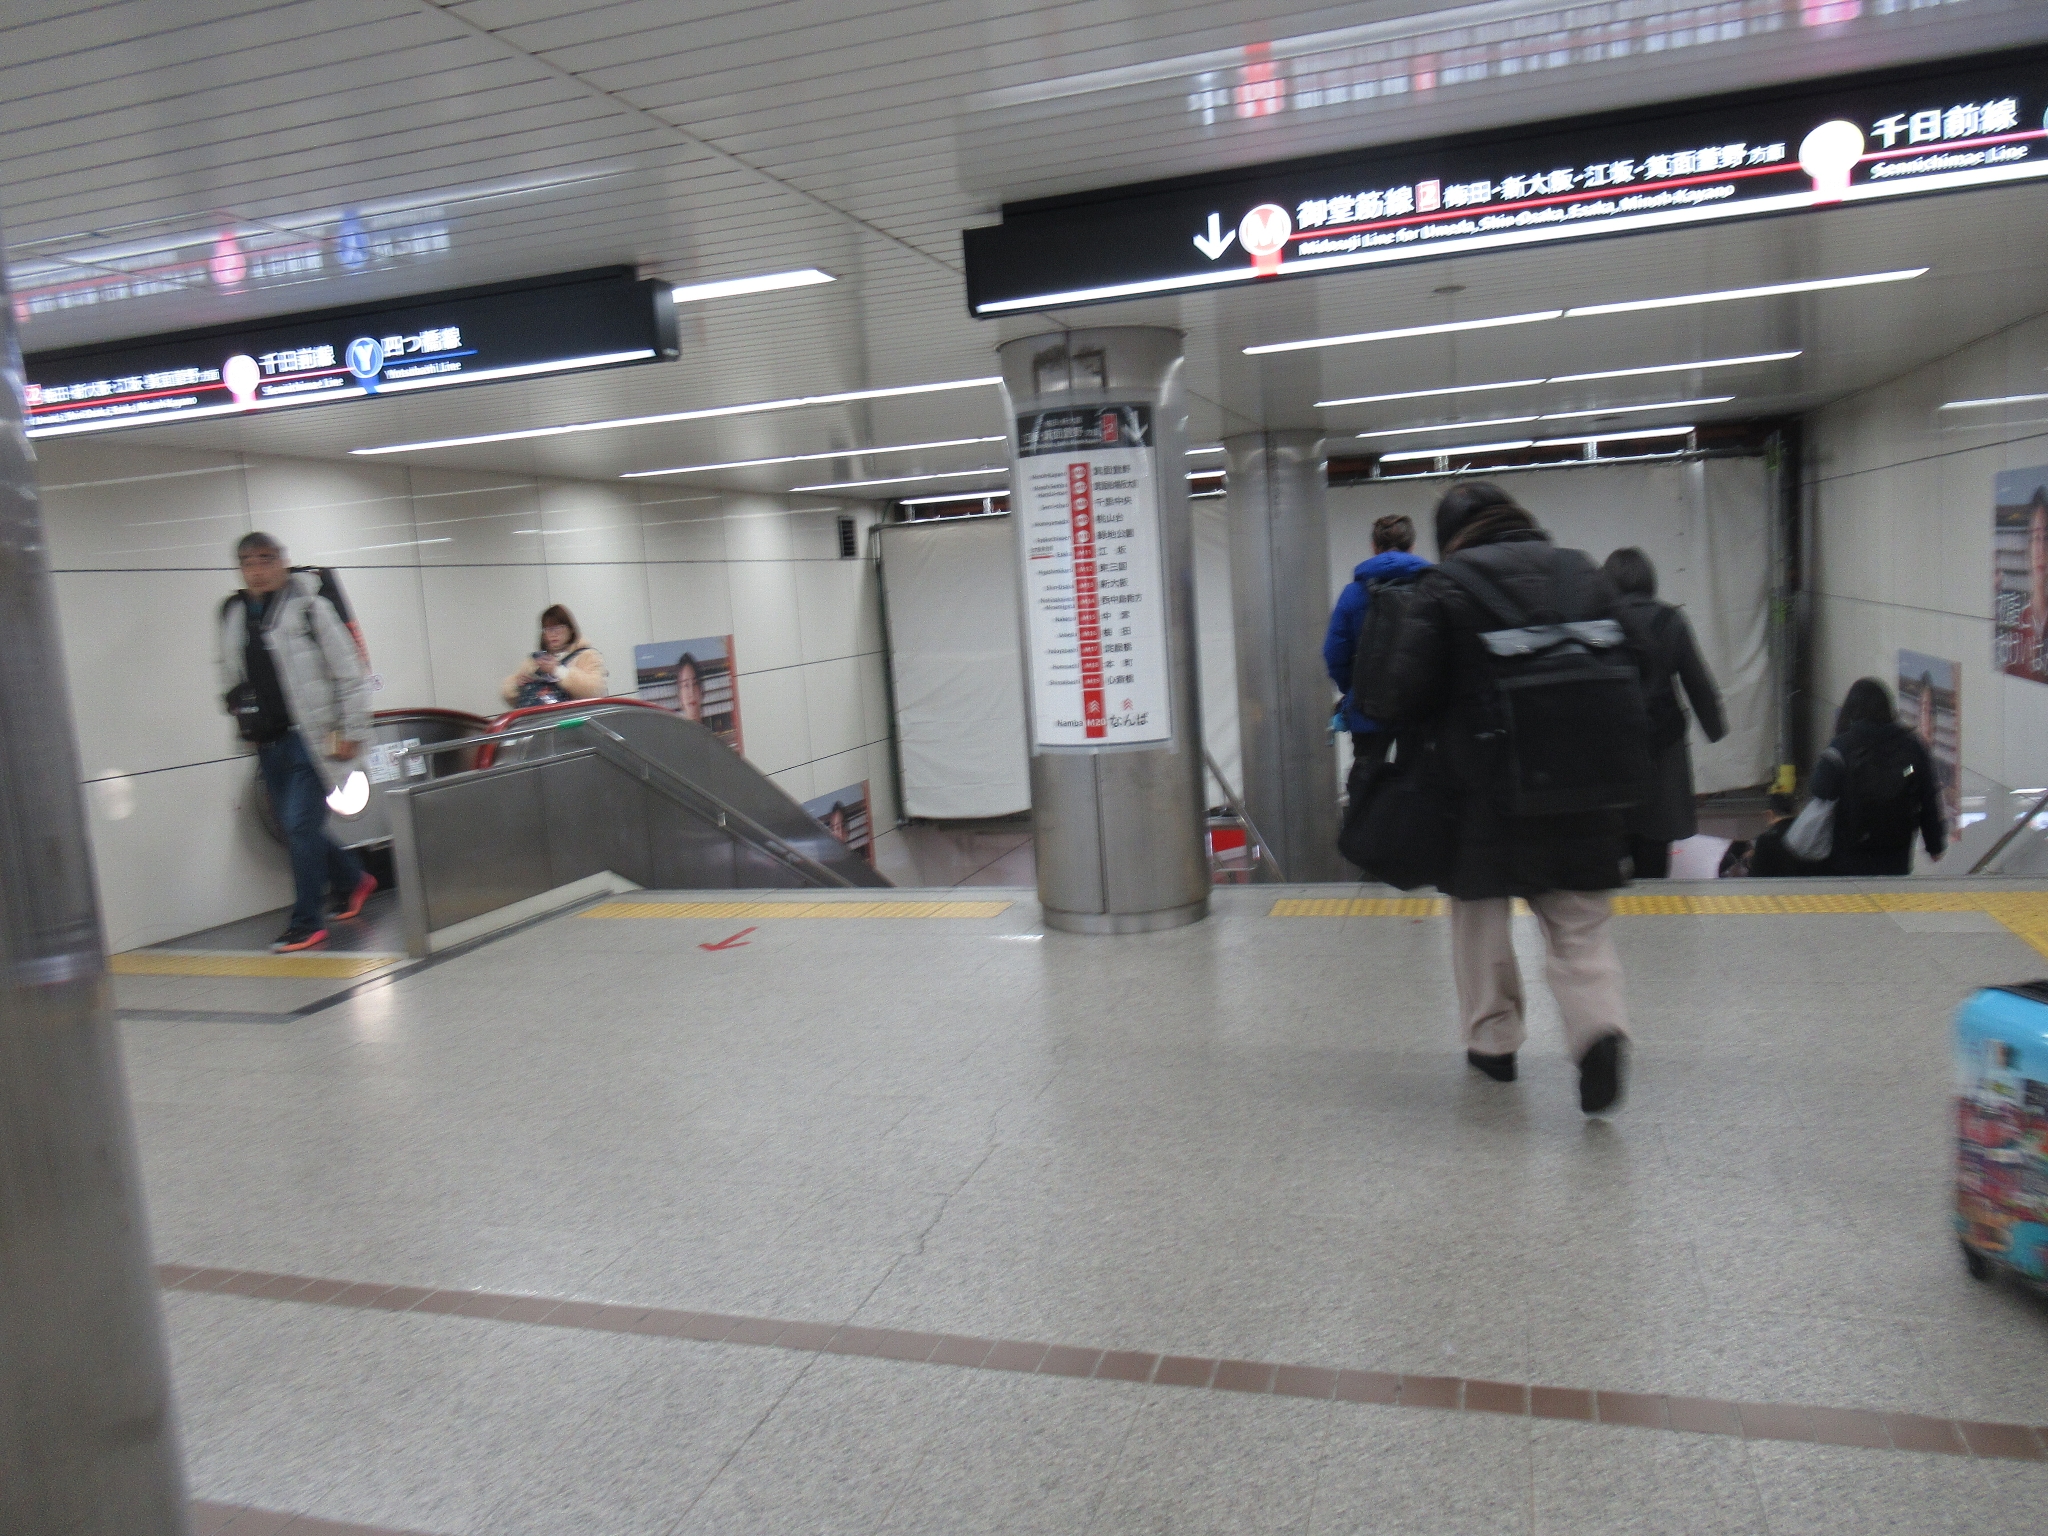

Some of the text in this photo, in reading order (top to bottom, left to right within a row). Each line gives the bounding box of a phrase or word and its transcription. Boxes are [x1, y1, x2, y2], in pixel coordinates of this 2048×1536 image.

[1870, 95, 2019, 148] 千日前線
[1985, 144, 2030, 165] Line
[1297, 185, 1415, 229] 御堂筋線
[1419, 185, 1437, 206] 2
[1254, 214, 1278, 247] M
[1299, 234, 1361, 256] Midosuji
[1362, 231, 1395, 248] Line
[1395, 227, 1420, 245] for
[381, 326, 462, 357] 四つ橋線
[258, 345, 336, 374] 千日前線
[354, 344, 374, 371] Y
[1095, 496, 1132, 506] 千里中央
[1096, 513, 1123, 522] 桃山台
[1097, 528, 1134, 539] 緑地公園
[1100, 578, 1128, 588] 新大阪
[1101, 593, 1142, 605] 西中島南方
[1107, 674, 1134, 685] 心斎橋
[1087, 718, 1106, 727] M20
[1109, 711, 1149, 728] なんば
